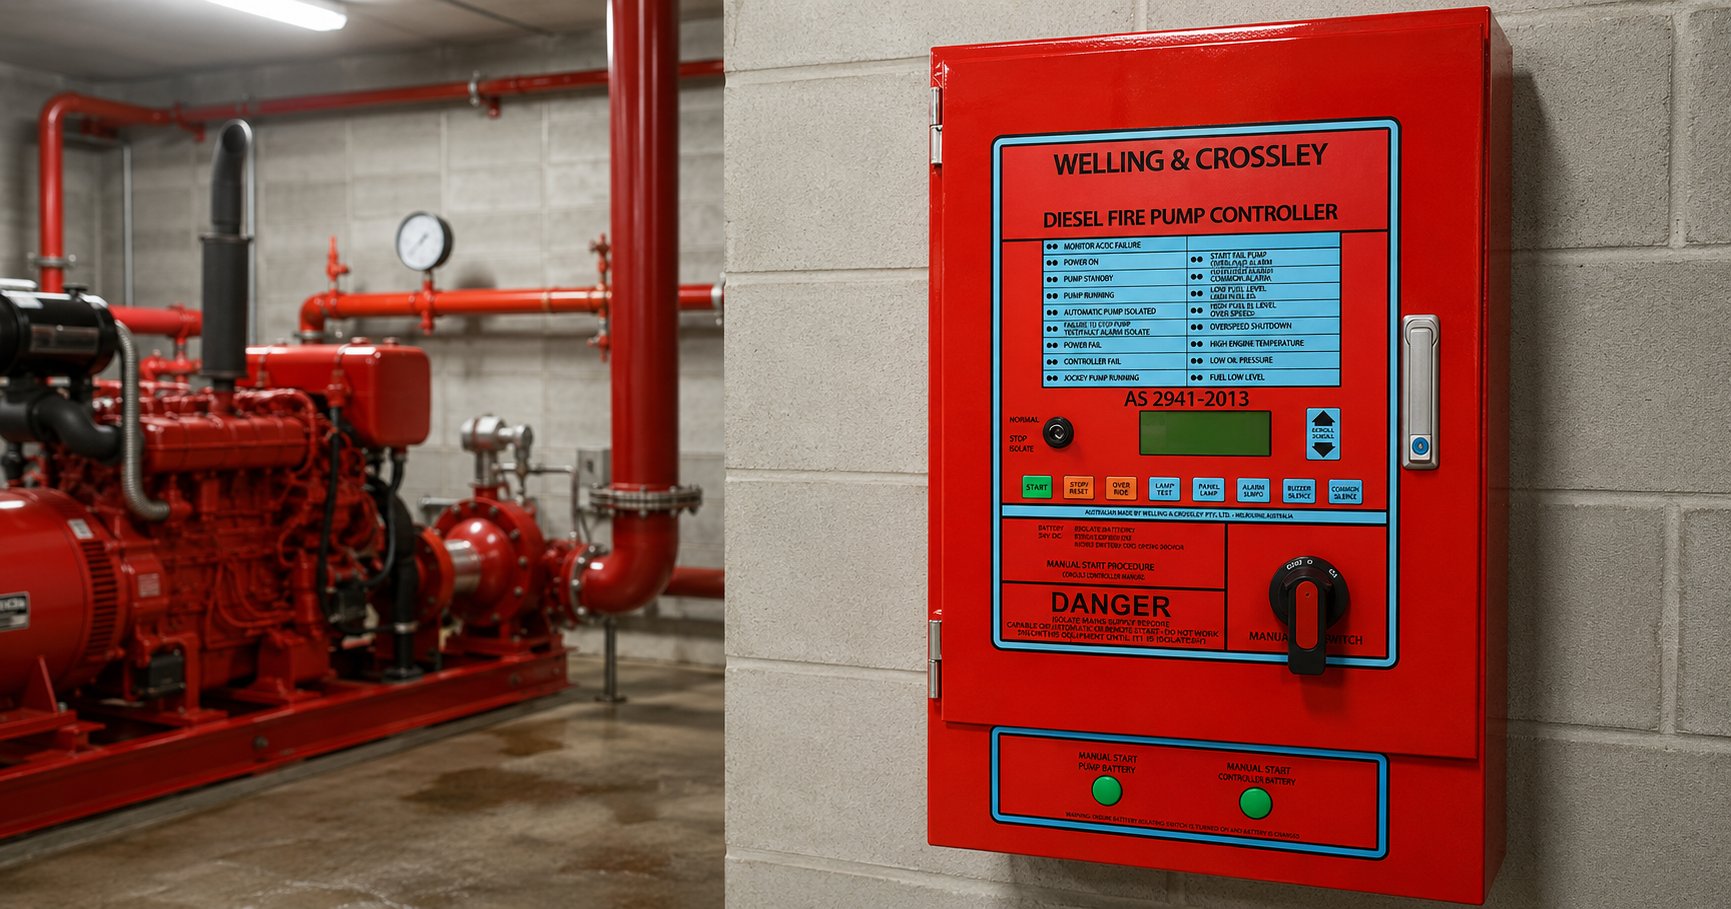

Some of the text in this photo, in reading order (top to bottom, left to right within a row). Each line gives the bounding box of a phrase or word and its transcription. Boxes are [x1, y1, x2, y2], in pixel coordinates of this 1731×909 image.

[1054, 142, 1329, 176] WELLING & CROSSLEY
[1043, 203, 1338, 228] DIESEL FIRE PUMP CONTROLLER
[1063, 242, 1095, 250] MONITOR
[1114, 241, 1141, 249] FAILURE
[1088, 258, 1099, 266] ON
[1063, 274, 1113, 283] PUMP STANDBY
[1063, 308, 1102, 316] AUTOMATIC
[1124, 307, 1156, 315] ISOLATED
[1210, 322, 1292, 331] OVERSPEED SHUTDOWN
[1124, 328, 1151, 336] ISOLATE
[1063, 341, 1087, 349] POWER
[1210, 339, 1305, 348] HIGH ENGINE TEMPERATURE
[1239, 356, 1273, 364] PRESSURE
[1088, 374, 1108, 382] PUMP
[1109, 374, 1140, 382] RUNNING
[1244, 373, 1265, 381] LEVEL
[1124, 390, 1249, 407] AS 2941-2013
[1009, 416, 1040, 424] NORMAL
[1009, 434, 1028, 443] STOP
[1009, 445, 1034, 453] ISOLATE
[1026, 483, 1048, 491] START
[1046, 560, 1155, 571] MANUAL START PROCEDURE
[1051, 591, 1172, 618] DANGER
[1194, 630, 1219, 638] WORK
[1079, 752, 1138, 763] MANUAL START
[1078, 762, 1136, 774] PUMP BATTERY
[1226, 762, 1292, 775] MANUAL START
[1218, 773, 1296, 786] CONTROLLER BATTERY
